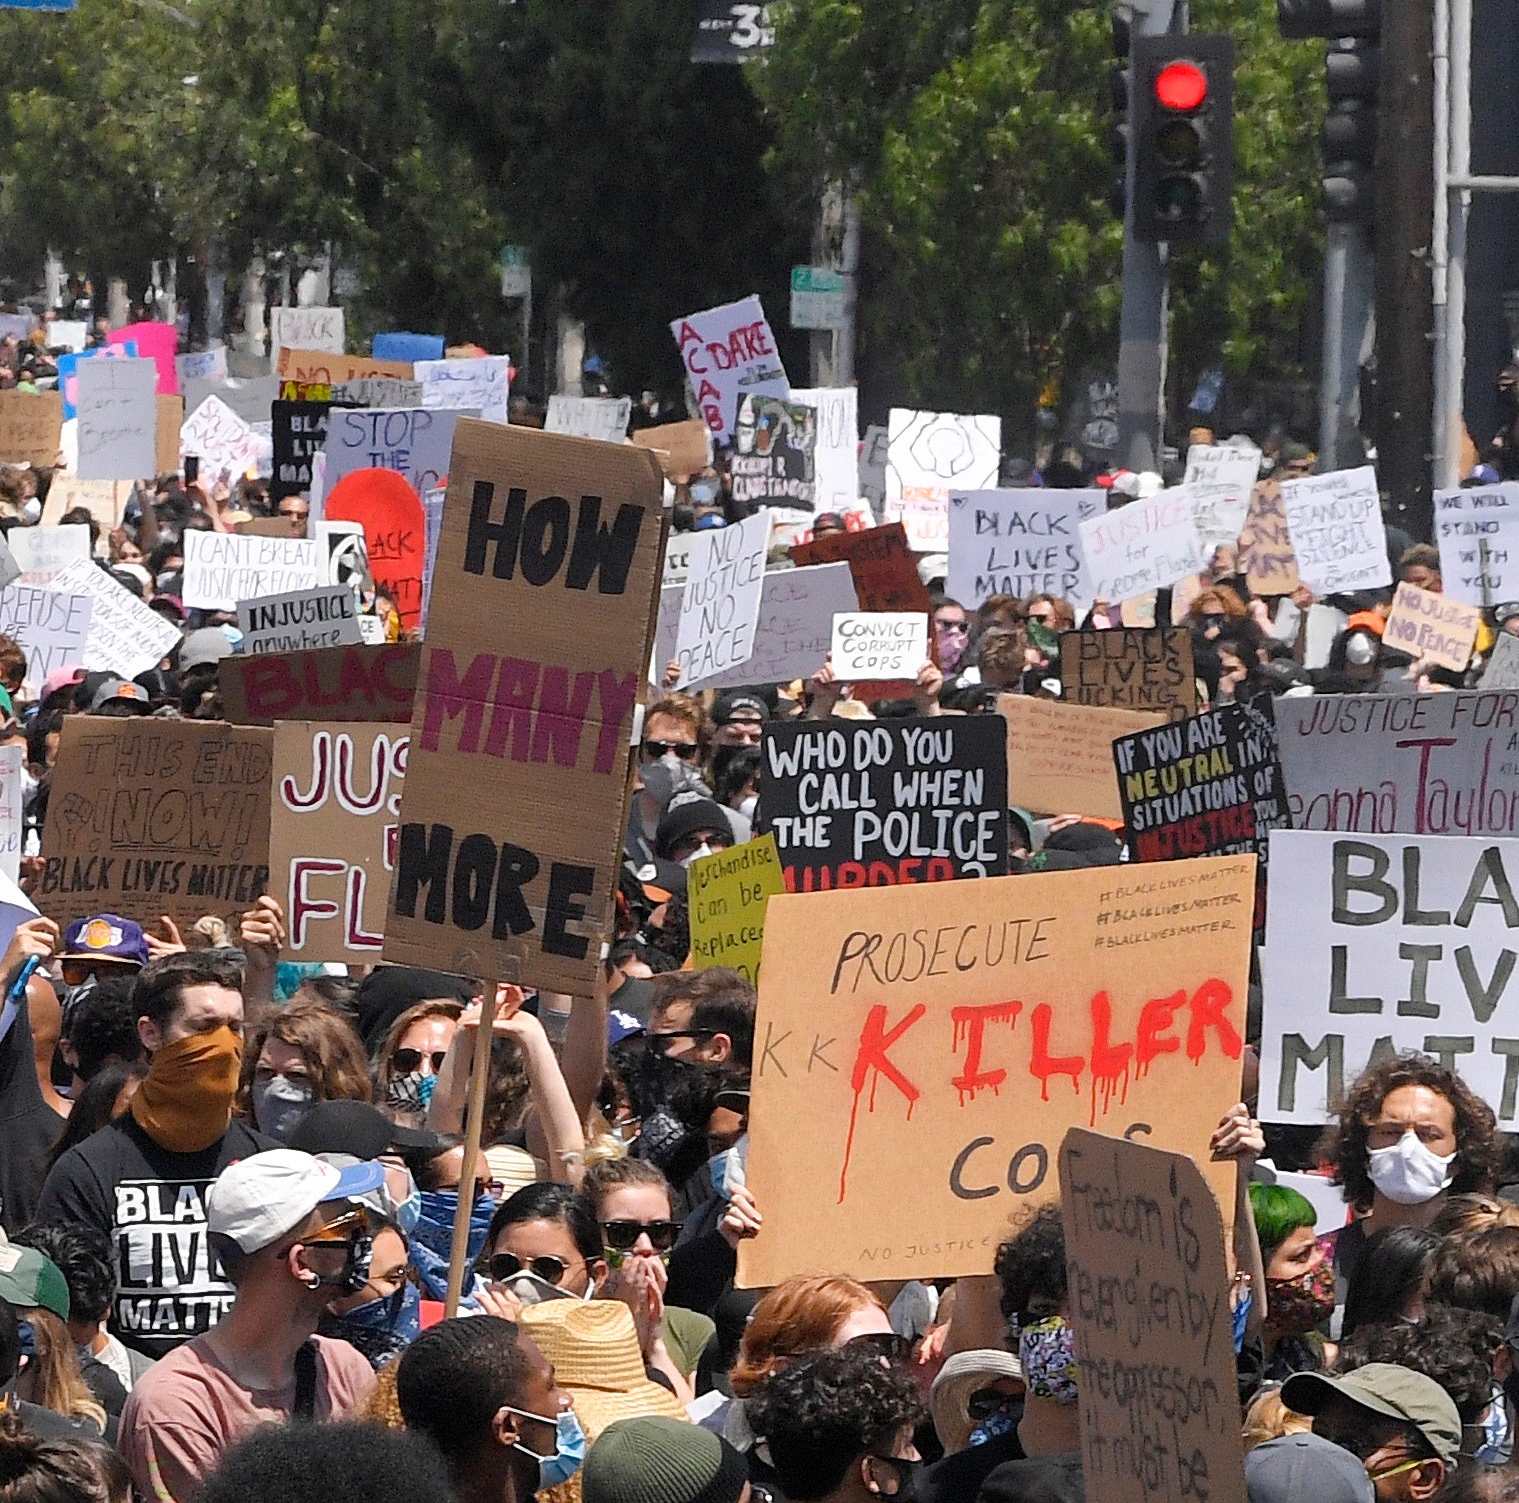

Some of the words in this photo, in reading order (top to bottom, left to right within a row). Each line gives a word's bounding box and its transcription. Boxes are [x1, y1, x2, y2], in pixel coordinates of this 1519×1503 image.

[341, 411, 433, 448] STOP
[368, 451, 411, 470] THE
[463, 480, 645, 595] HOW
[974, 511, 1069, 536] BLACK
[1091, 500, 1187, 554] JUSTICE
[1441, 521, 1499, 537] STAND
[708, 522, 744, 572] NO
[987, 546, 1080, 573] LIVES
[684, 551, 762, 613] JUSTICE
[975, 574, 1081, 599] MATTER
[0, 588, 89, 634] REFUSE
[248, 594, 354, 632] INJUSTICE
[700, 594, 735, 638] NO
[838, 620, 919, 638] CONVICT
[678, 624, 747, 681] PEACE
[842, 638, 916, 654] CORRUPT
[852, 655, 902, 669] COPS
[1080, 631, 1179, 659] BLACK
[1080, 658, 1183, 686] LIVES
[418, 647, 640, 776] MANY
[1300, 697, 1437, 735] JUSTICE
[1450, 694, 1518, 729] FOR
[768, 730, 845, 778] WHO
[853, 727, 893, 771] DO
[900, 727, 953, 764] YOU
[1118, 739, 1135, 773] IF
[1142, 725, 1182, 767] YOU
[1187, 712, 1227, 753] ARE
[798, 772, 877, 814] CALL
[894, 768, 984, 807] WHEN
[1126, 746, 1233, 802] NEUTRAL
[1237, 737, 1262, 768] IN
[1133, 774, 1248, 830] SITUATIONS
[1254, 766, 1275, 795] OF
[772, 816, 832, 848] THE
[854, 810, 999, 861] POLICE
[1137, 802, 1256, 861] INJUSTICE
[41, 855, 113, 895] BLACK
[121, 858, 186, 896] LIVES
[187, 863, 270, 902] MATTER
[395, 821, 599, 960] MORE
[698, 898, 728, 923] can
[740, 882, 763, 906] be
[830, 918, 1057, 994] PROSECUTE
[759, 1021, 792, 1079] K
[808, 1036, 839, 1073] K
[849, 979, 1243, 1115] KILLER
[1169, 1163, 1201, 1273] is
